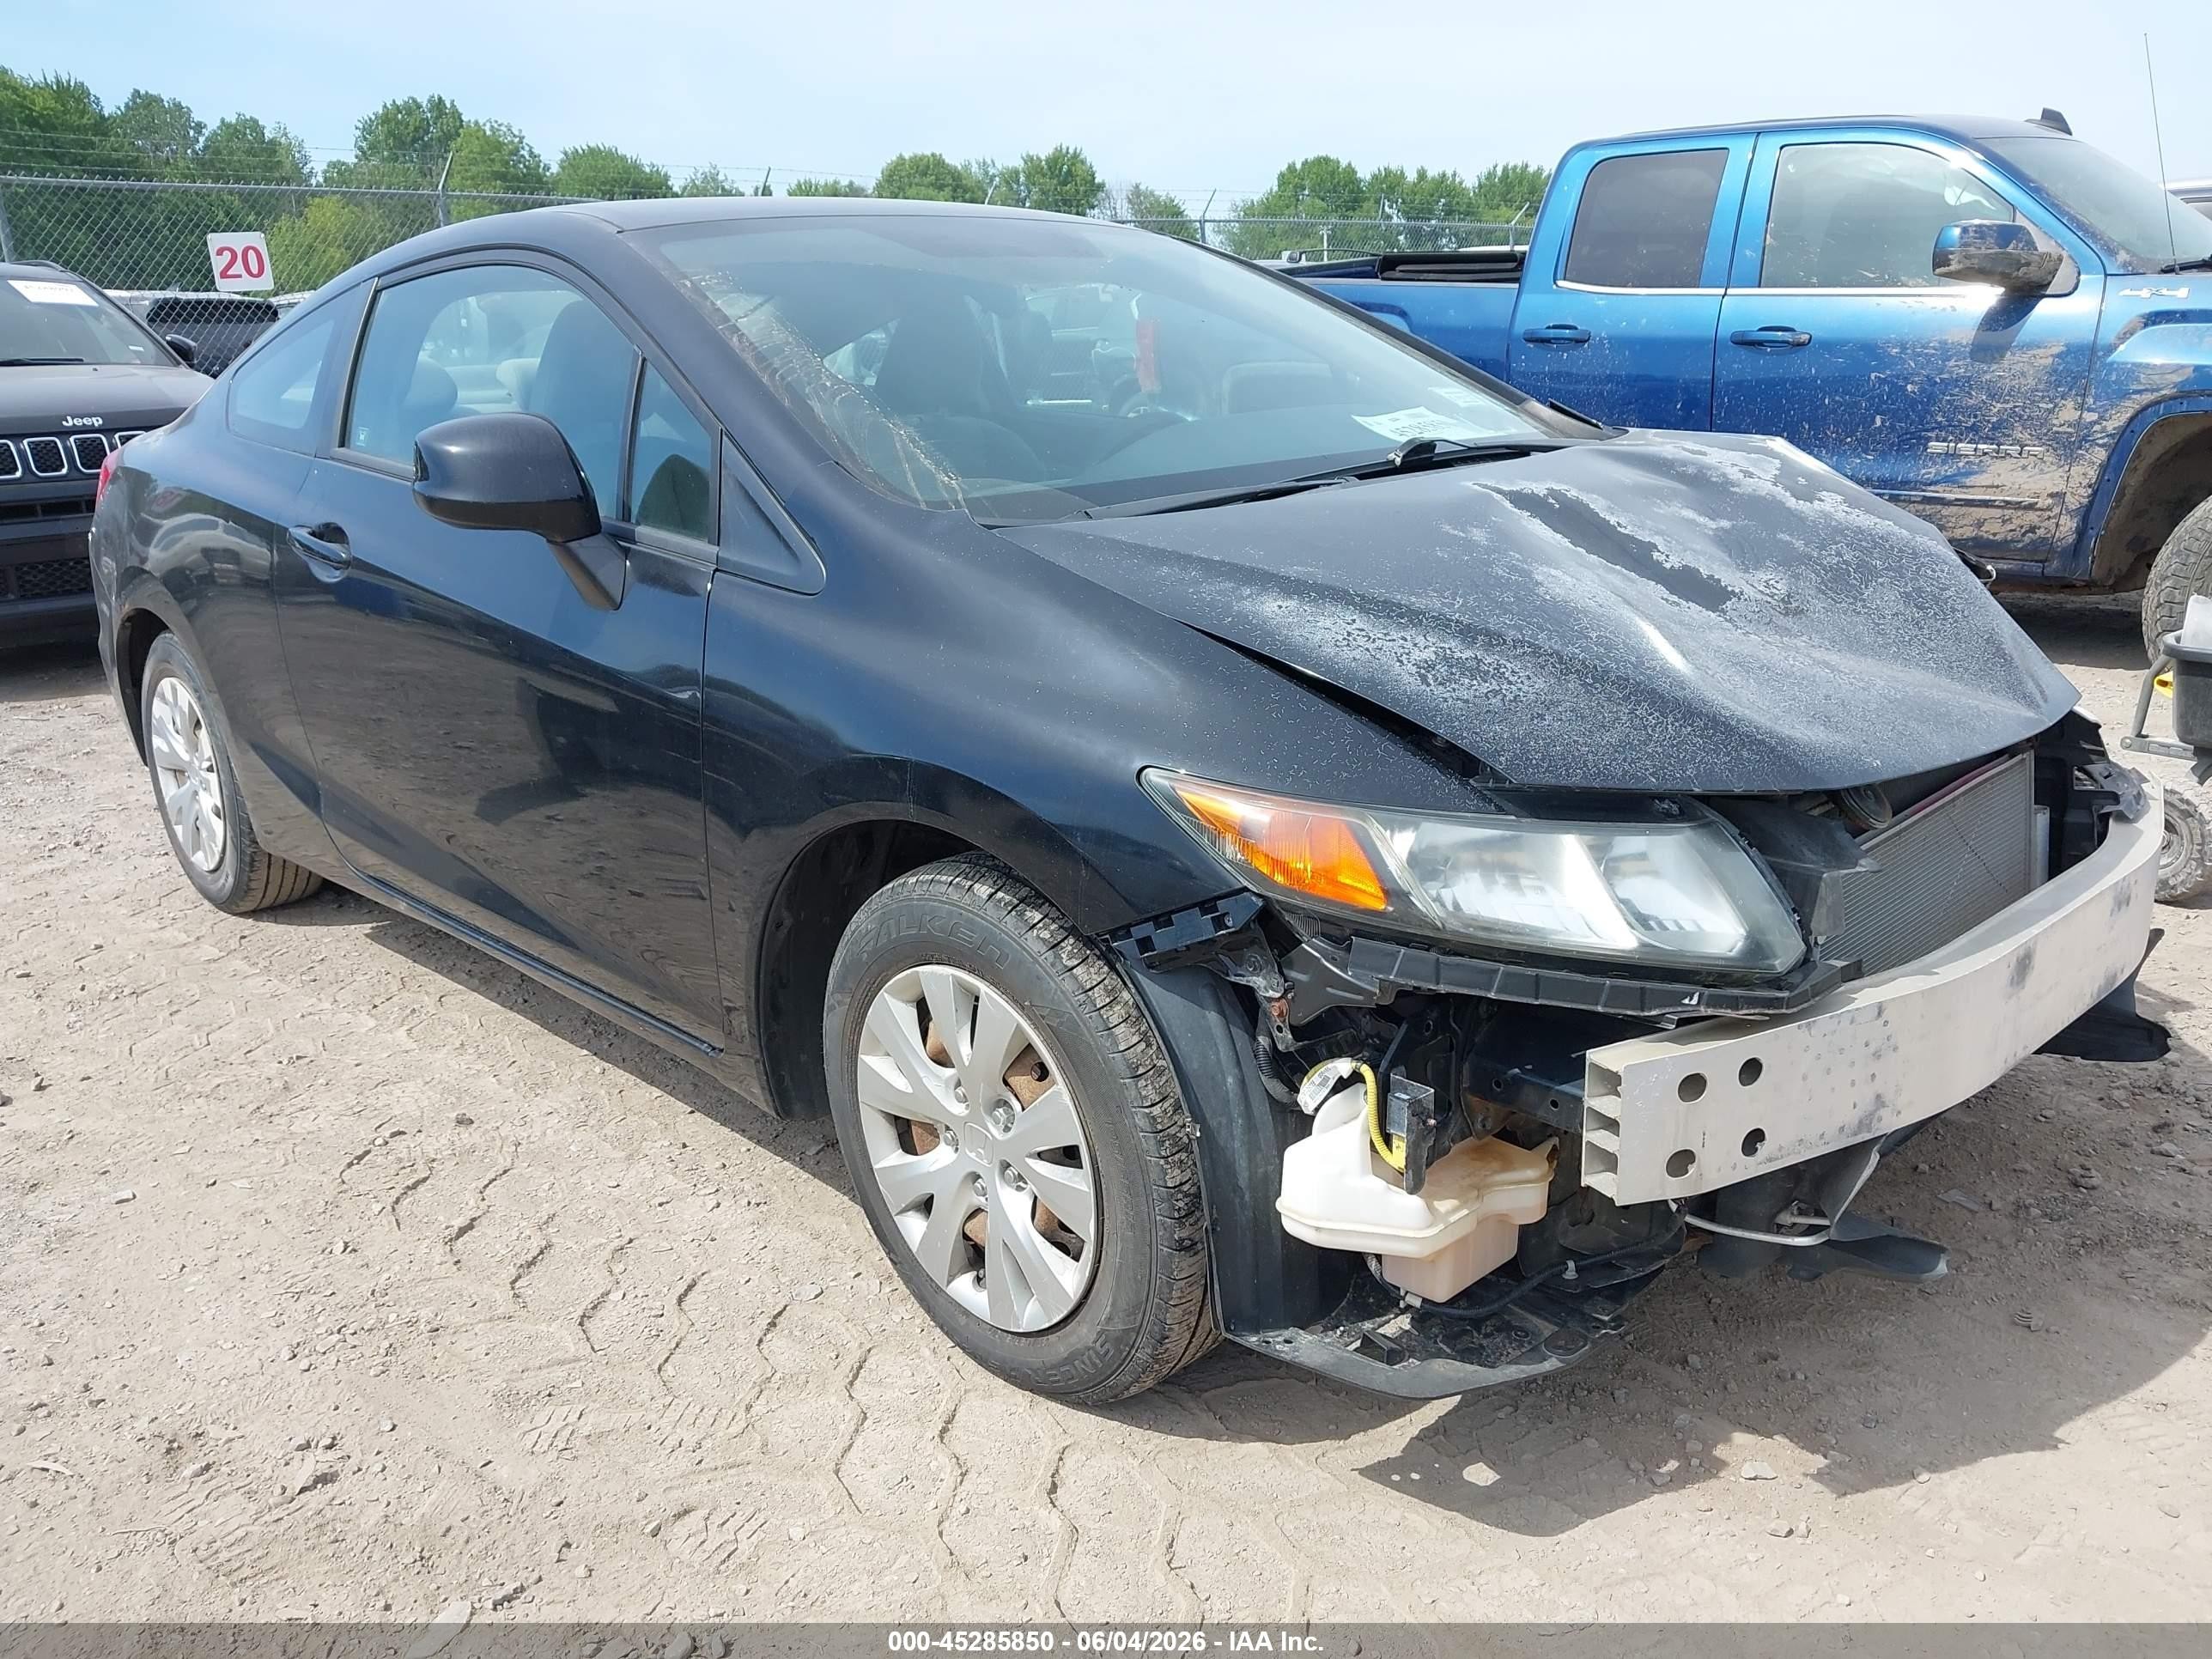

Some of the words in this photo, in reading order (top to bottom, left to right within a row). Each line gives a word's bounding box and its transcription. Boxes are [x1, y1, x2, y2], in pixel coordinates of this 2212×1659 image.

[216, 246, 265, 280] 20
[62, 416, 103, 427] Jeep
[1926, 441, 2045, 460] SIERRA
